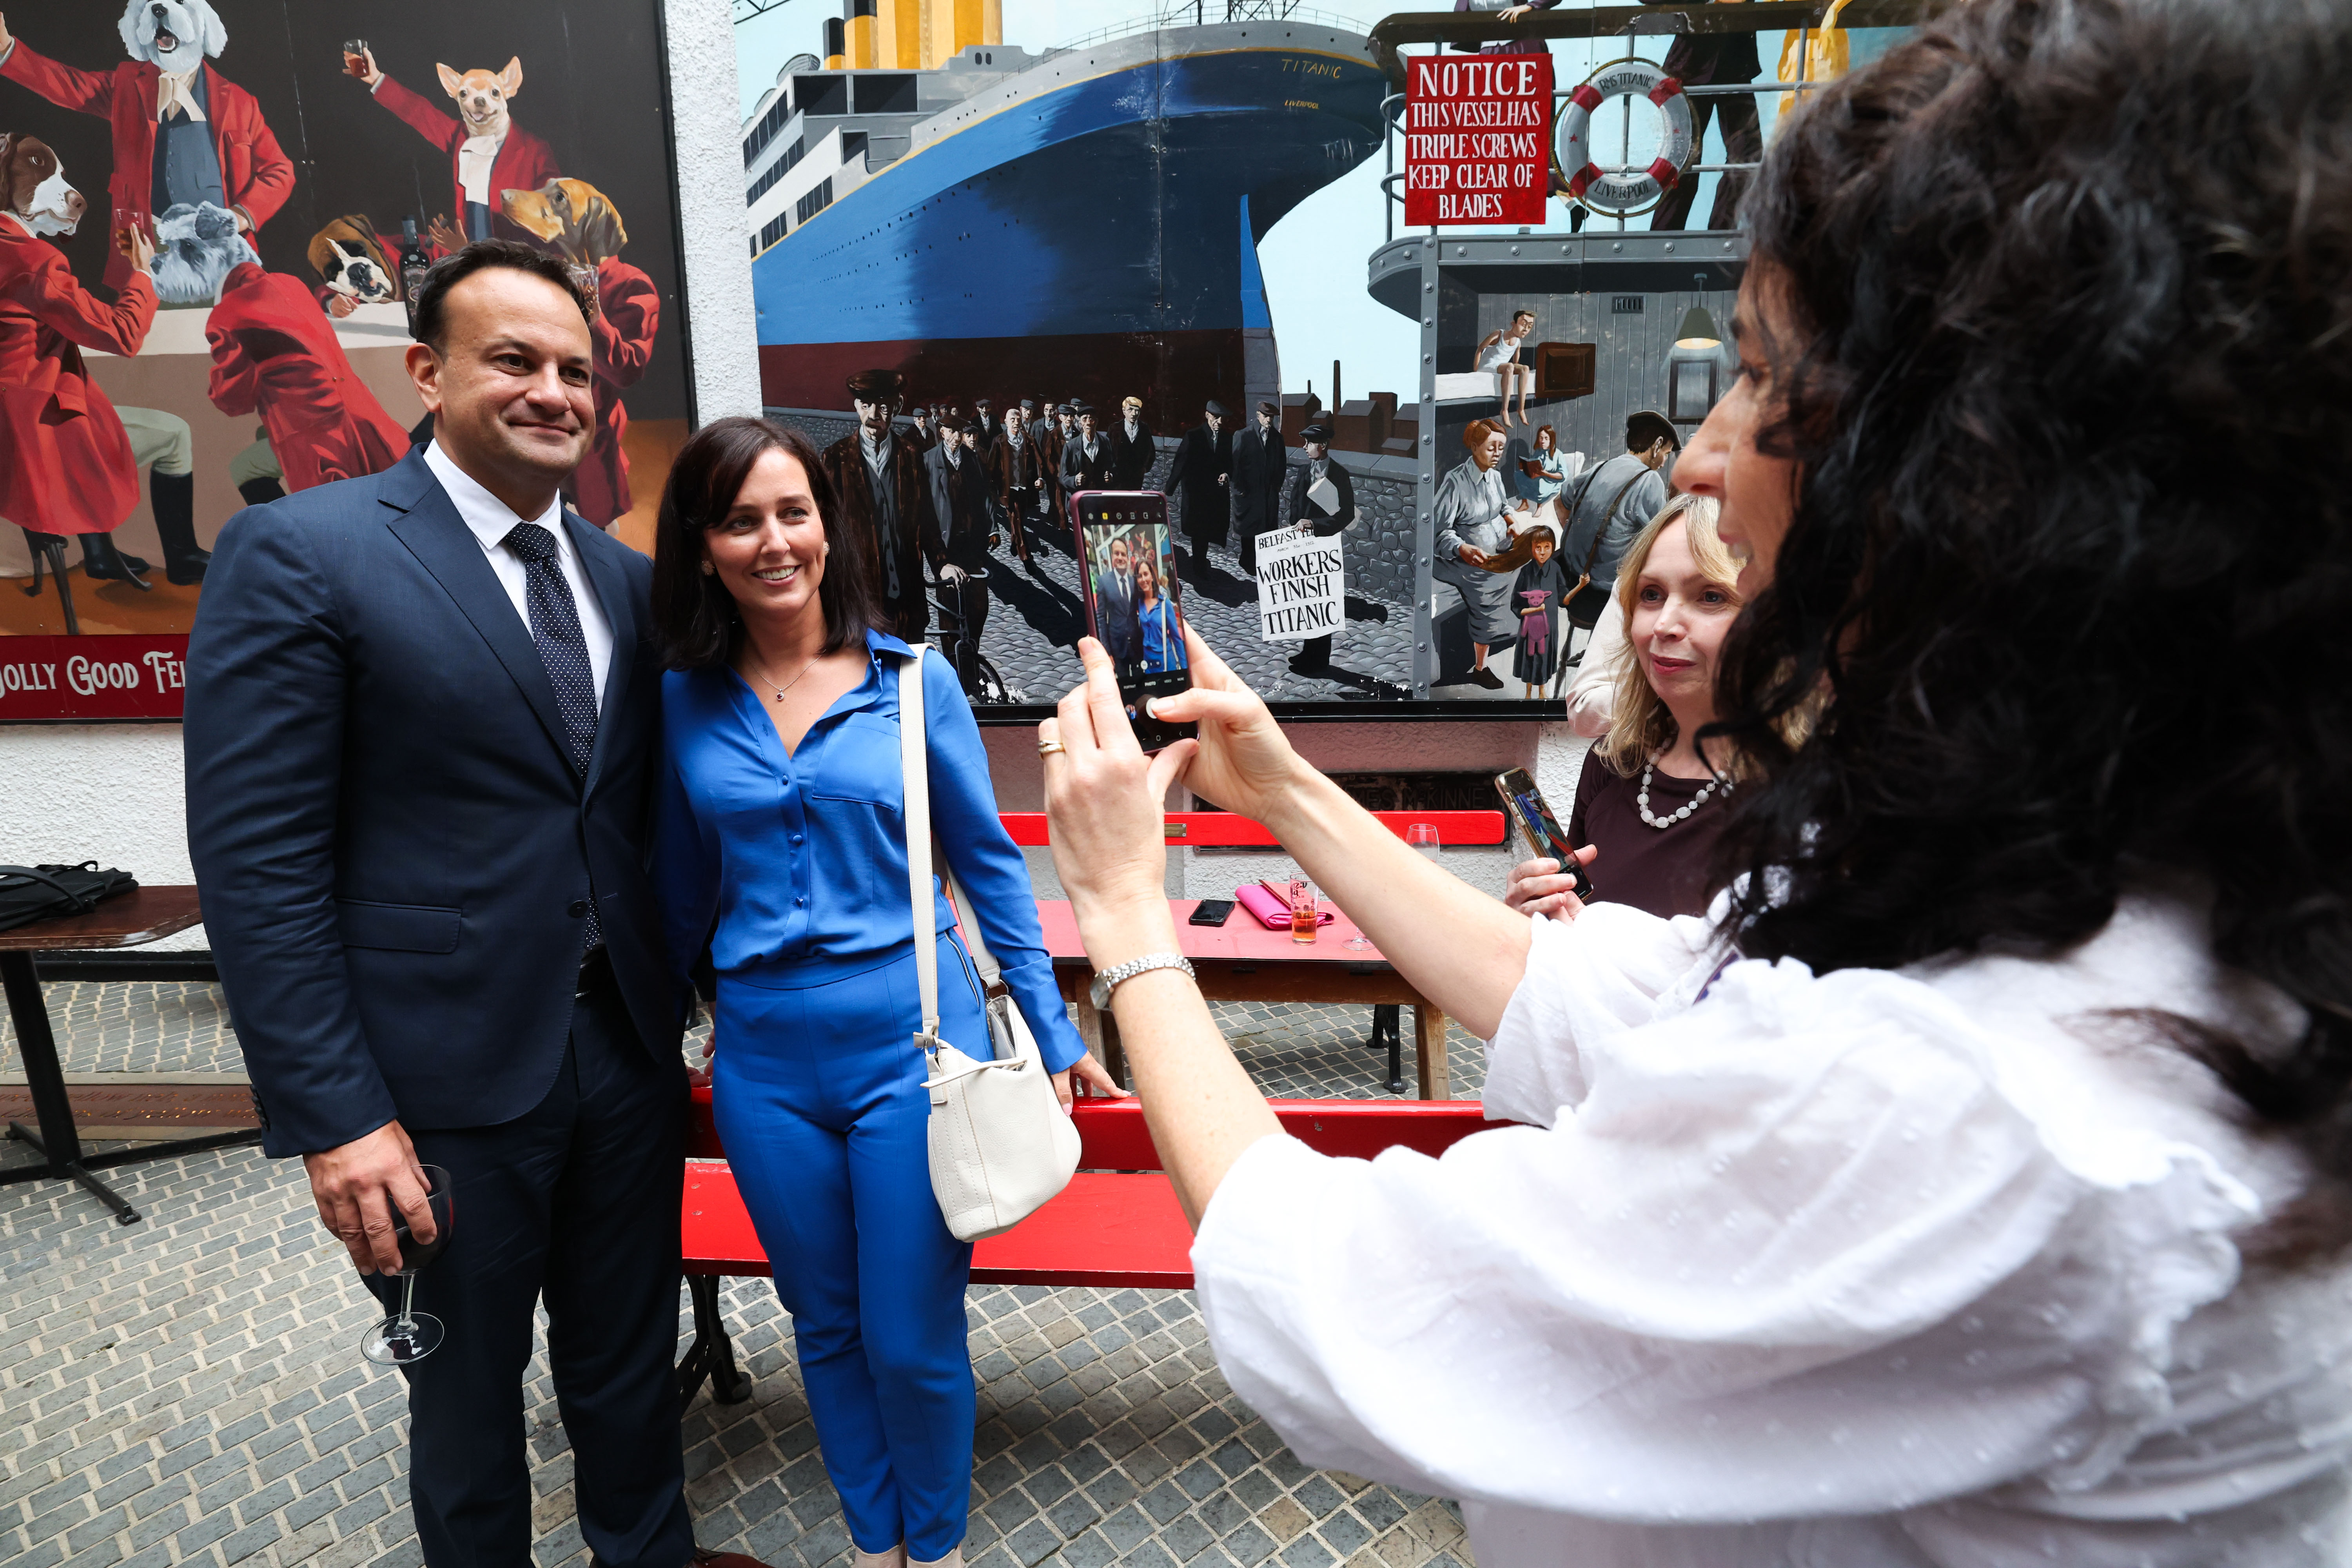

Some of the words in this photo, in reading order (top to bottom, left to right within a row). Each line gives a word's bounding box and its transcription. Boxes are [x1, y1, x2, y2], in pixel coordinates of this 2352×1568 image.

[1282, 59, 1341, 78] TITANIC
[1416, 61, 1537, 97] NOTICE
[1598, 74, 1617, 92] RMS
[1617, 73, 1654, 89] TITANIC
[1285, 99, 1319, 109] LIVERPOOL
[1411, 102, 1449, 127] THIS
[1451, 102, 1506, 127] VESSEL
[1506, 101, 1541, 126] HAS
[1408, 134, 1468, 159] TRIPLE
[1472, 133, 1537, 158] SCREWS
[1408, 165, 1450, 189] KEEP
[1456, 163, 1508, 189] CLEAR
[1514, 163, 1535, 187] OF
[1594, 180, 1652, 199] LIVERPOOL
[1439, 193, 1503, 219] BLADES
[1258, 530, 1297, 550] BELFAST
[1257, 549, 1342, 585] WORKERS
[1269, 574, 1331, 605] FINISH
[1264, 601, 1340, 634] TITANIC
[66, 655, 140, 696] GOOD
